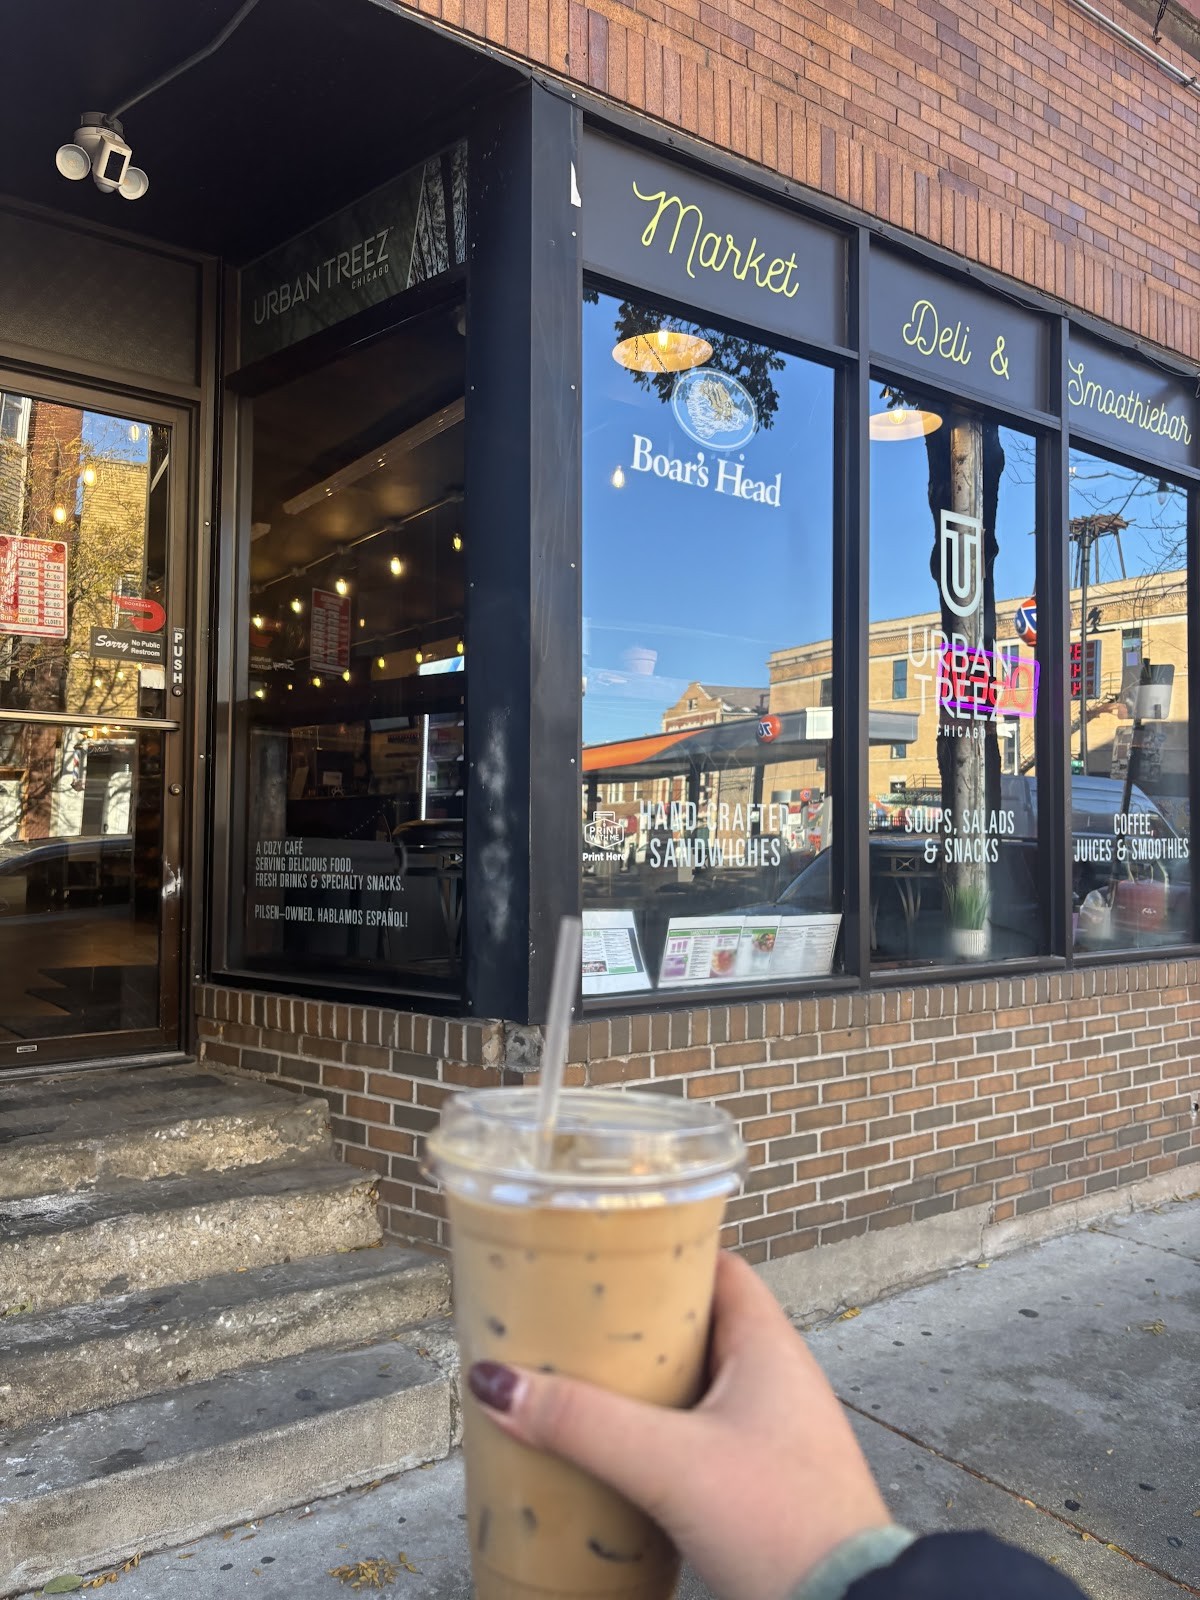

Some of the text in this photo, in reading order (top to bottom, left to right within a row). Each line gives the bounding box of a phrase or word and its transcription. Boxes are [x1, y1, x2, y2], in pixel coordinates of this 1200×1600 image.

[632, 181, 799, 298] Market
[254, 228, 390, 325] URBAN TREEZ
[351, 264, 389, 290] CHICAGO
[903, 299, 1010, 380] Deli &
[1067, 359, 1192, 446] Smoothiebar
[630, 434, 782, 508] Boar's Head
[95, 635, 129, 652] Sorry
[130, 647, 160, 657] Restroom
[908, 625, 1011, 678] URBAN
[173, 632, 183, 684] PUSH
[914, 673, 1005, 722] TREEZ
[937, 724, 986, 739] CHICAGO
[640, 799, 790, 833] HAND CRAFTED
[904, 807, 1015, 836] SOUPS, SALADS
[1114, 813, 1154, 836] COFFEE,
[589, 826, 619, 835] PRINT
[255, 838, 303, 855] A COZY CAFÉ
[582, 852, 604, 861] Print
[650, 838, 781, 868] SANDWICHES
[924, 838, 999, 864] & SNACKS
[1074, 838, 1189, 863] JUICES & SMOOTHIES
[255, 857, 353, 873] SERVING DELICIOUS FOOD,
[255, 873, 404, 891] FRESH DRINKS & SPECIALTY SNACKS.
[318, 907, 363, 925] HABLAMOS
[366, 907, 408, 928] ESPAÑOL!
